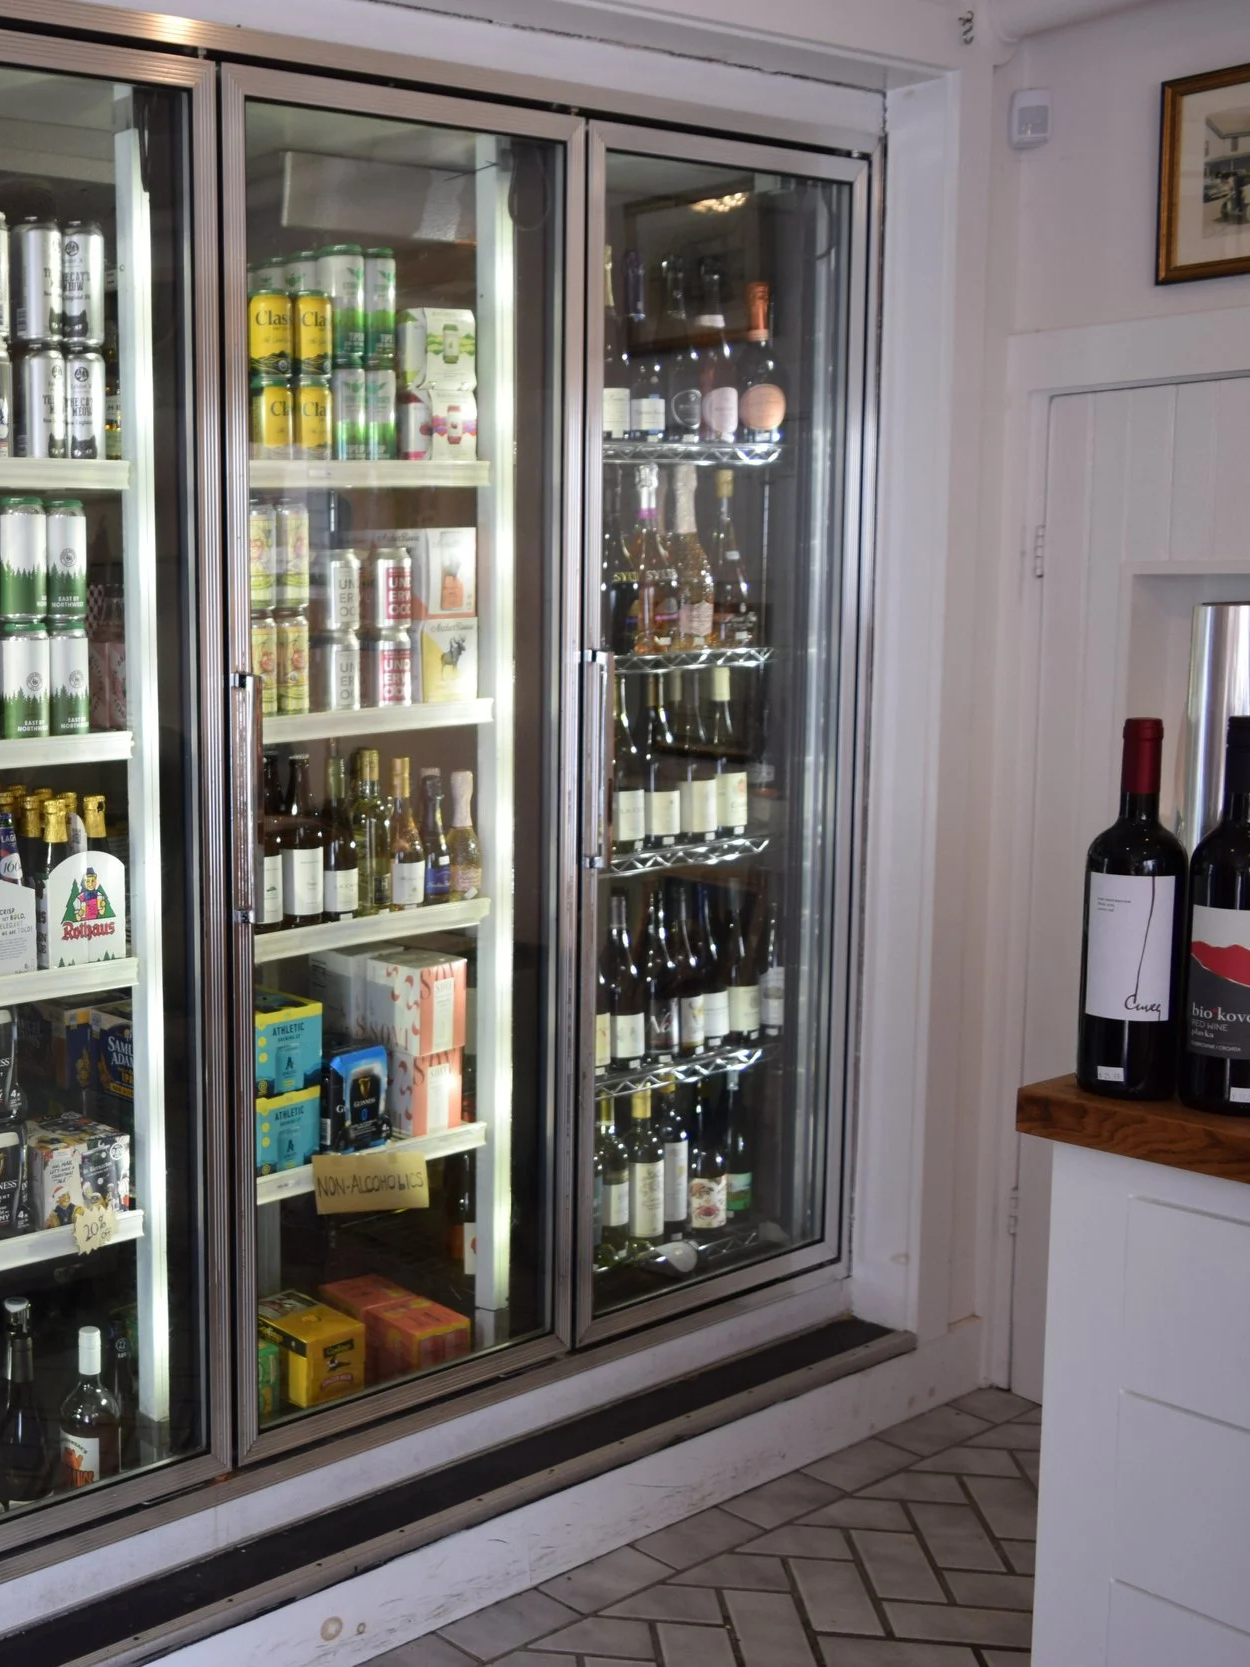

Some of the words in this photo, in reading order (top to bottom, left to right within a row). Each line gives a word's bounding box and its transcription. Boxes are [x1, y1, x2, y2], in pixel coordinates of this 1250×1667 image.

[0, 907, 15, 916] CRISP
[61, 920, 116, 941] Rothaus
[1191, 1002, 1213, 1019] bio
[272, 1022, 305, 1037] ATHLETIC
[1191, 1019, 1206, 1027] RED
[1206, 1022, 1229, 1032] WINE
[274, 1105, 305, 1121] ATHLETIC
[317, 1171, 425, 1199] NON-ALCOHOLICS
